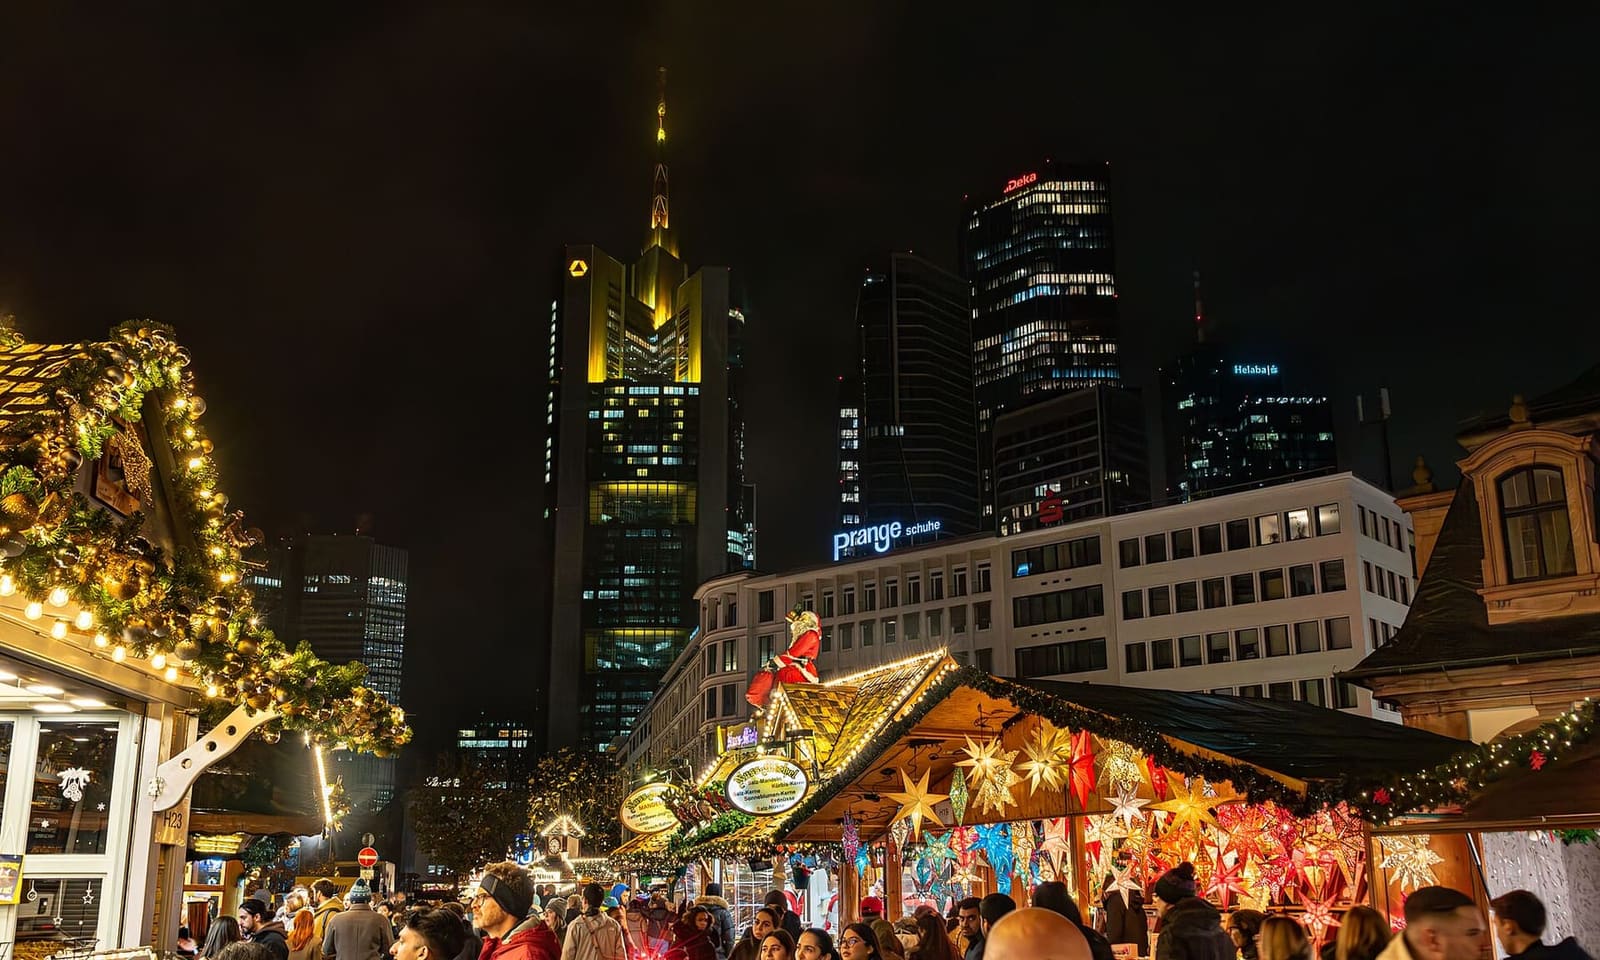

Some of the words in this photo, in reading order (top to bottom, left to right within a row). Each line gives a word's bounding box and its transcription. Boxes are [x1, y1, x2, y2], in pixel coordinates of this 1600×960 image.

[1008, 172, 1037, 191] Deka
[1234, 365, 1267, 374] Helaba
[906, 520, 941, 536] schuhe
[163, 810, 183, 829] H23
